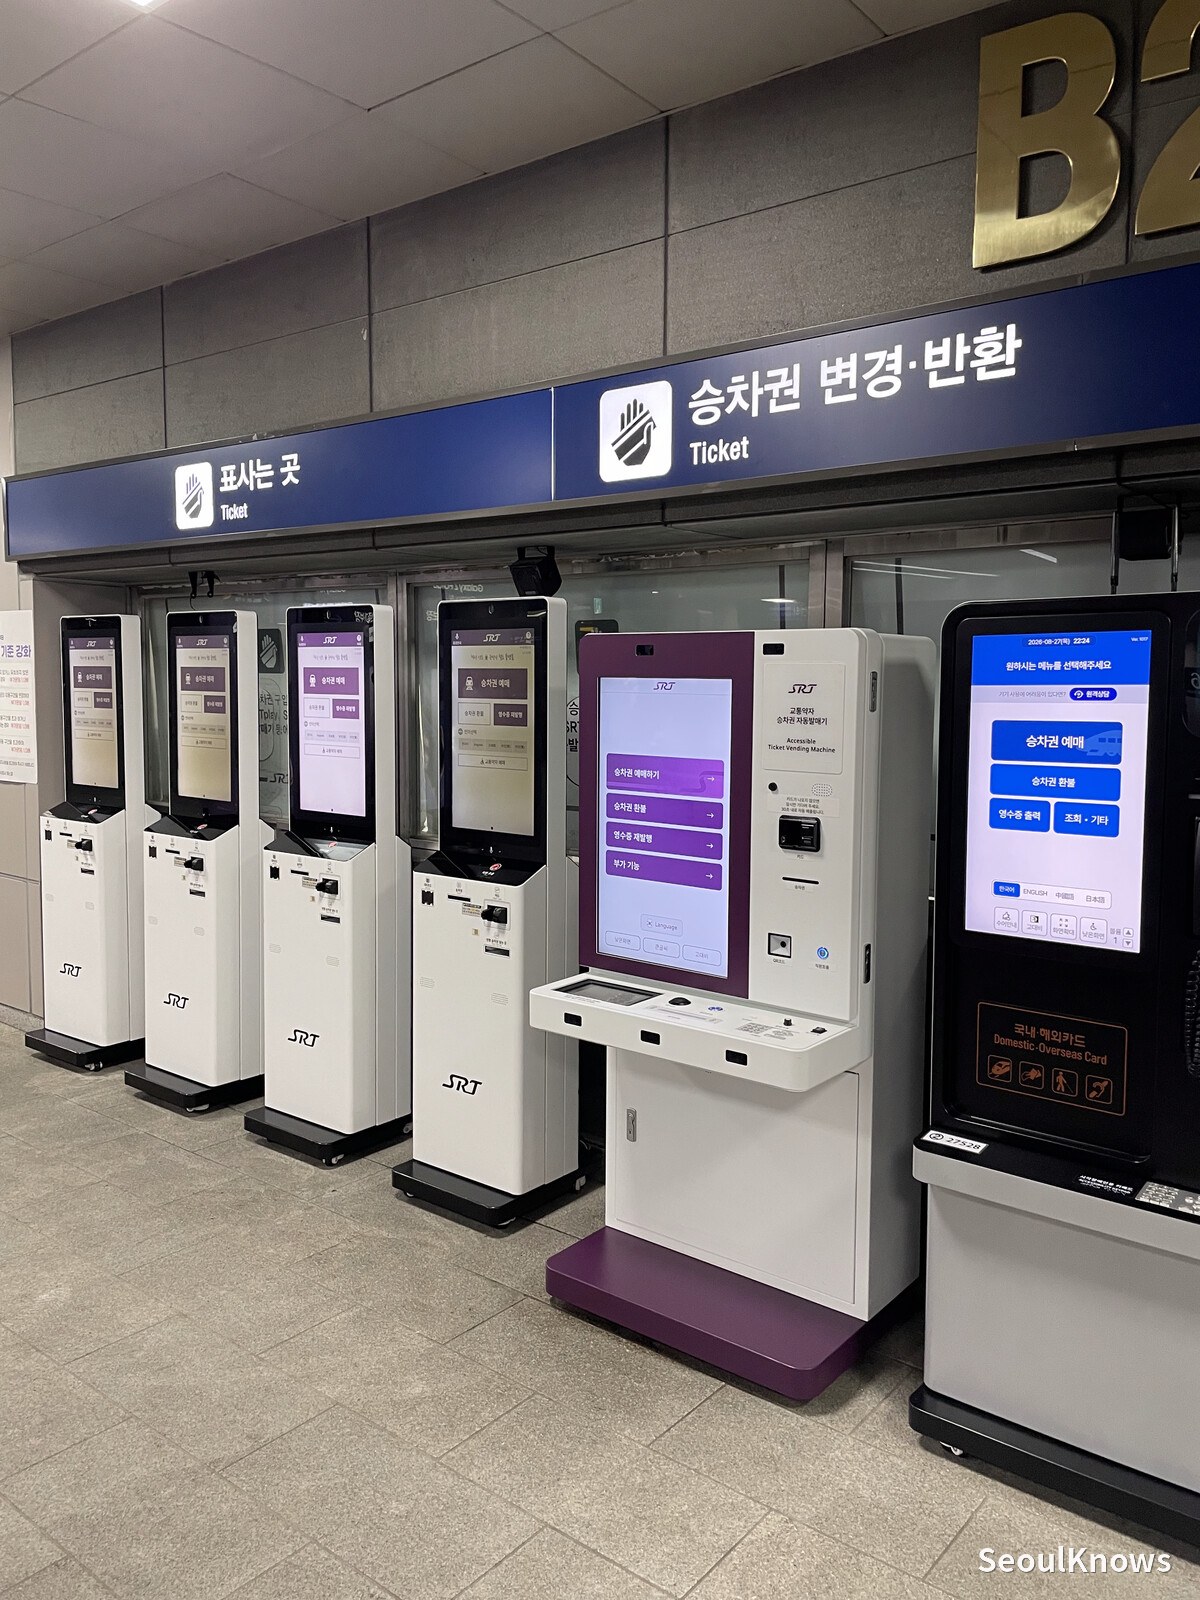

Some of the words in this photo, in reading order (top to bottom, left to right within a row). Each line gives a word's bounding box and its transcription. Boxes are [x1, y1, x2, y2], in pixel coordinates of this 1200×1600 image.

[688, 364, 801, 427] 승차권
[818, 322, 1024, 406] 변경·반환
[689, 435, 750, 467] Ticket
[219, 459, 275, 492] 표사는
[280, 453, 301, 488] 곳
[220, 502, 249, 521] Ticket
[323, 636, 337, 644] SRT
[483, 633, 501, 642] SRT
[1073, 637, 1091, 645] 22:24
[16, 645, 31, 658] 강화
[1005, 661, 1037, 671] 원하시는
[1037, 661, 1062, 671] 메뉴를
[1063, 660, 1112, 671] 선택해주세요
[321, 676, 335, 685] 승차권
[480, 678, 498, 688] 승차권
[498, 679, 510, 688] 예매
[653, 681, 676, 691] SRT
[788, 683, 818, 694] SRT
[1086, 690, 1110, 698] 원격상담
[789, 707, 815, 715] 교통약자
[776, 716, 795, 724] 승차권
[796, 717, 828, 726] 자동발매기
[786, 737, 816, 745] Accessible
[1025, 735, 1059, 749] 승차권
[1061, 735, 1085, 749] 예매
[786, 745, 810, 754] Vending
[614, 767, 633, 779] 승차권
[633, 768, 660, 780] 예매하기
[1031, 776, 1057, 787] 승차권
[1058, 777, 1076, 788] 환불
[614, 802, 633, 812] 승차권
[633, 803, 647, 814] 환불
[998, 809, 1023, 820] 영수증
[1024, 810, 1041, 821] 출력
[1064, 813, 1082, 824] 조회
[1090, 815, 1109, 826] 기타
[613, 830, 633, 842] 영수증
[633, 832, 653, 844] 재발행
[613, 859, 626, 869] 부가
[627, 860, 640, 871] 기능
[998, 885, 1015, 893] 한국어
[1023, 888, 1048, 897] ENGLISH
[1085, 894, 1106, 904] 日本語
[654, 921, 678, 931] Language
[1052, 927, 1075, 936] 화면확대
[60, 963, 82, 978] SRT
[163, 993, 190, 1010] SRT
[287, 1028, 320, 1048] SRT
[1013, 1023, 1087, 1049] 국내·해외카드
[993, 1033, 1083, 1060] Domestic·Overseas
[1084, 1051, 1108, 1066] Card
[442, 1073, 483, 1096] SRT
[946, 1137, 982, 1151] 27528
